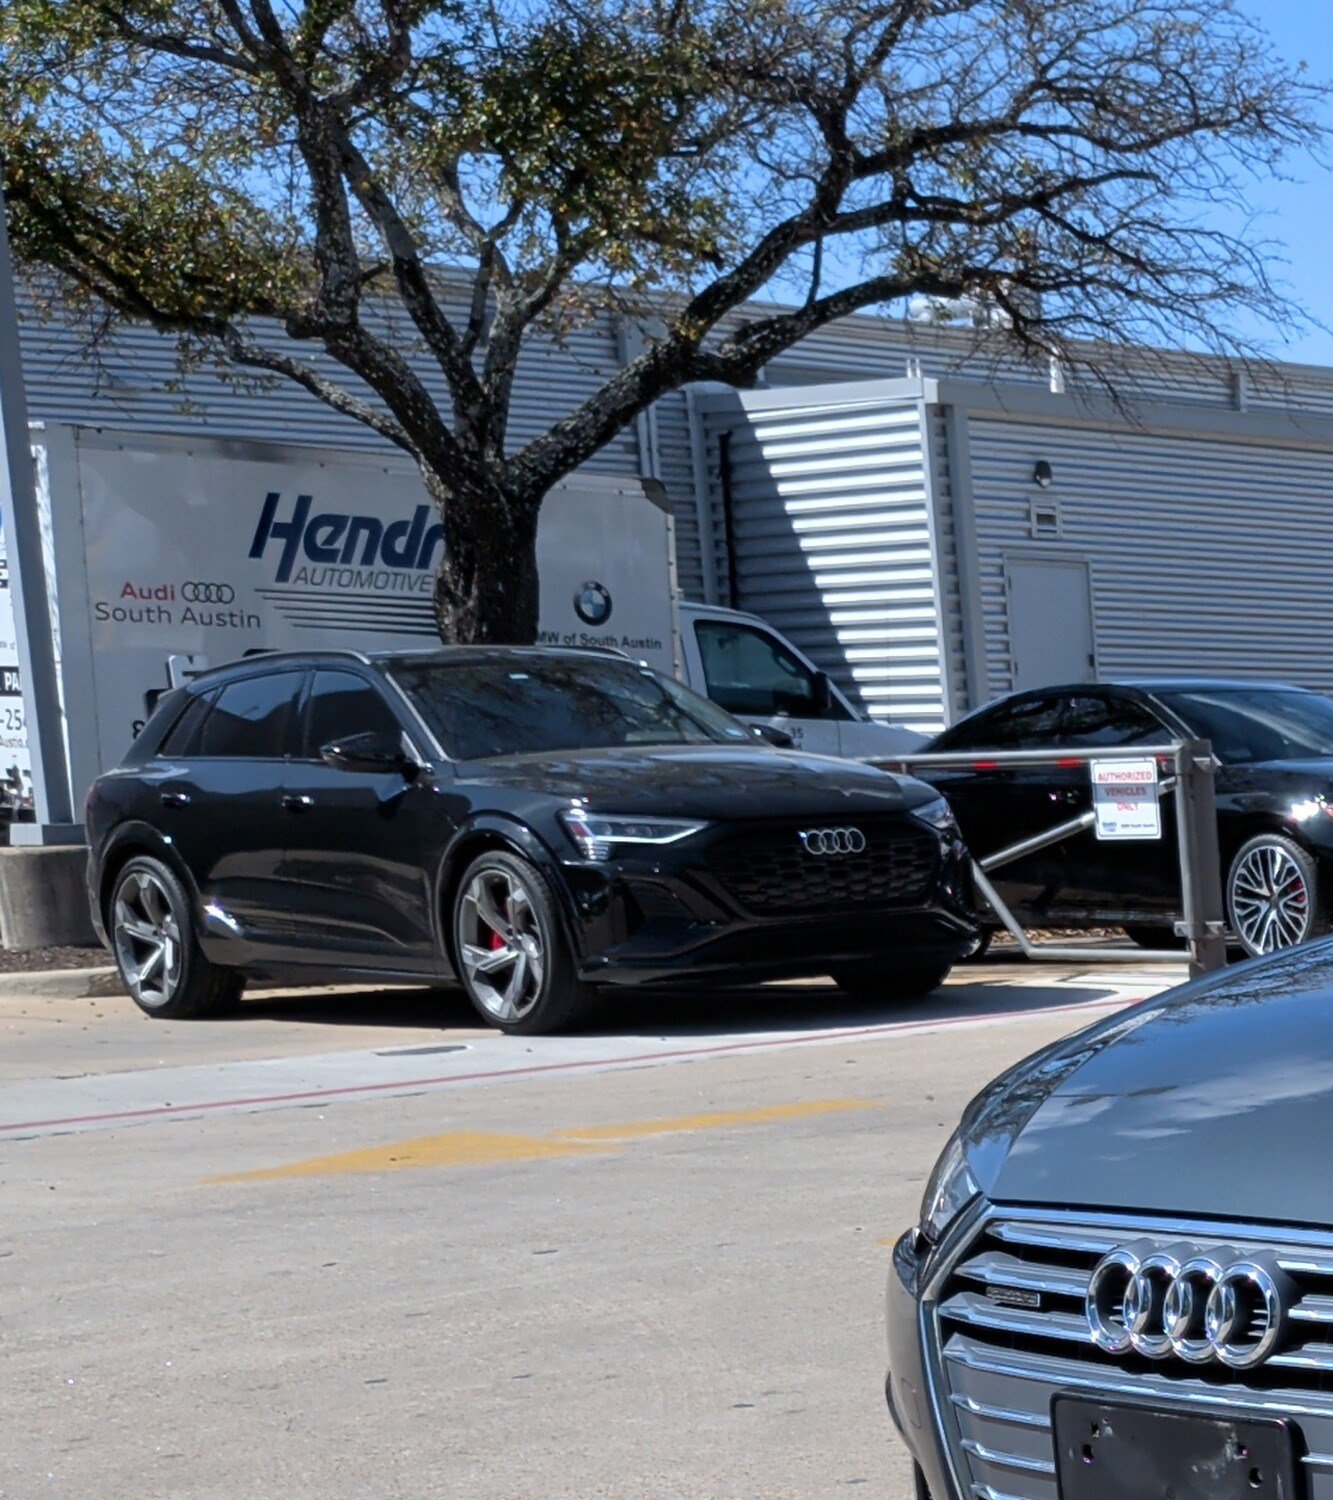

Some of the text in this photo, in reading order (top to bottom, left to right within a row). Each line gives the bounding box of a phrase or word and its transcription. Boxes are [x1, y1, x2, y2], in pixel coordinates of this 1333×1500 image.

[293, 566, 434, 593] AUTOMOTIVE
[120, 581, 175, 601] Audi
[94, 602, 261, 628] South Austin
[563, 632, 577, 646] of
[580, 633, 618, 647] South
[620, 636, 663, 649] Austin
[1097, 771, 1152, 781] AUTHORIZED
[1104, 786, 1147, 796] VEHICLES
[1117, 801, 1138, 811] ONLY
